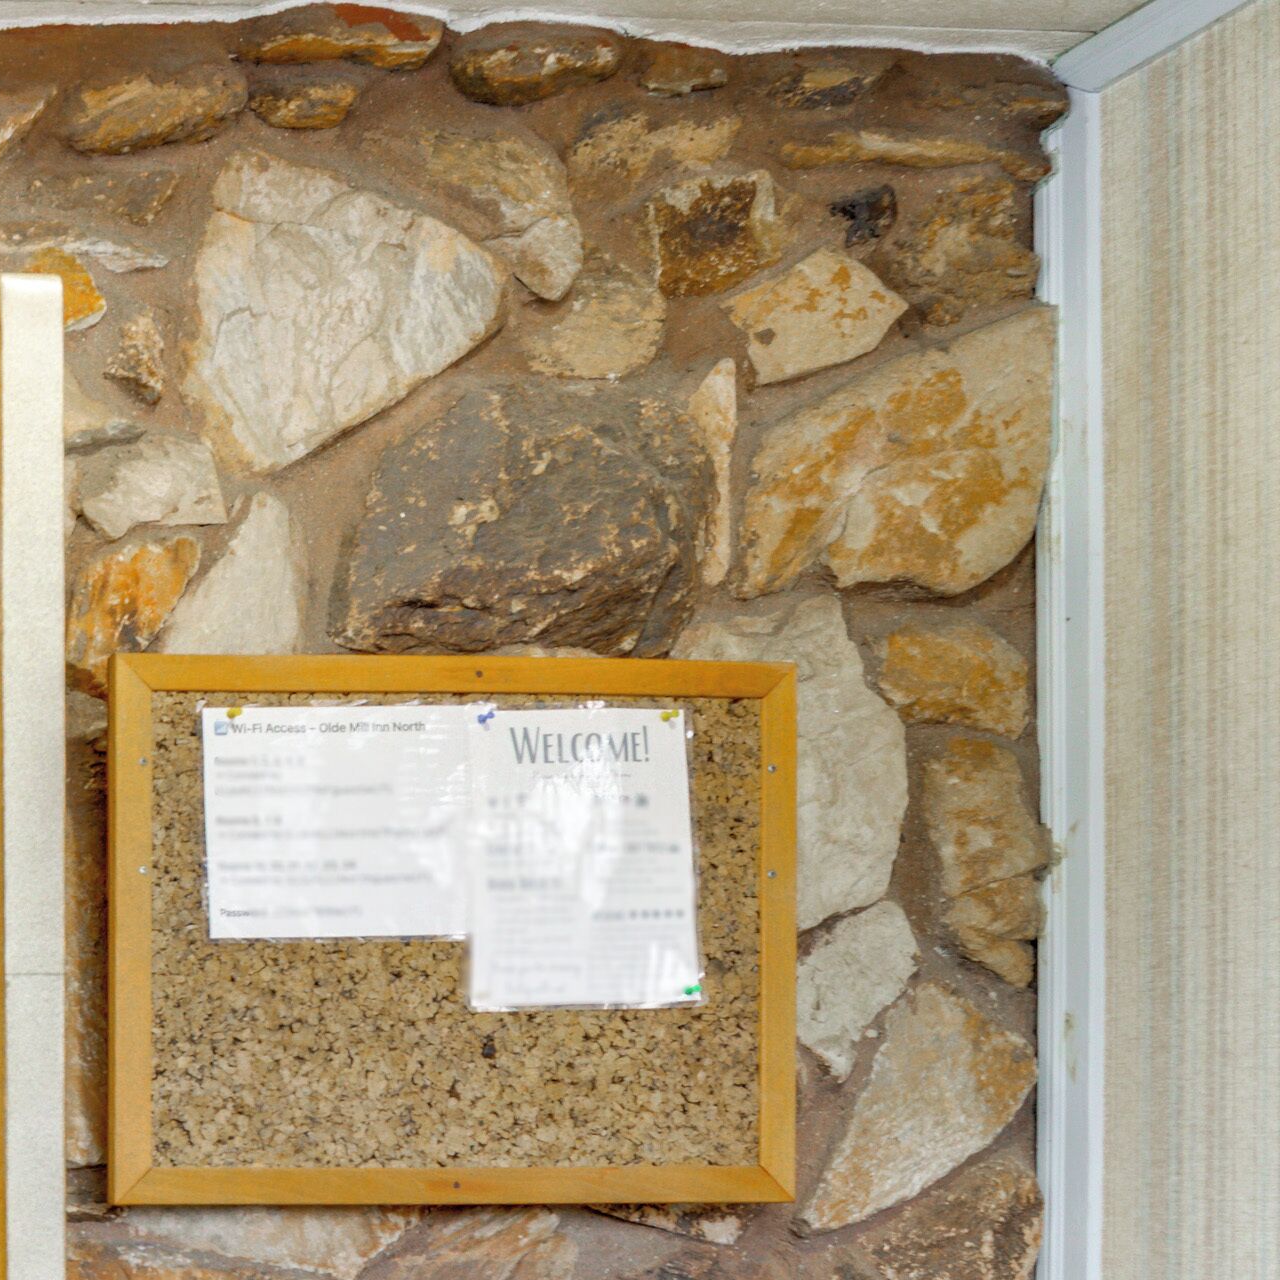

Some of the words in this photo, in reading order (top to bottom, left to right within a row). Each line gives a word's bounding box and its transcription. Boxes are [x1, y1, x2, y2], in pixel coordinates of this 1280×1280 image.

[231, 722, 262, 734] Wi-Fi
[266, 722, 306, 734] Access
[319, 722, 346, 734] Olde
[392, 721, 425, 733] North
